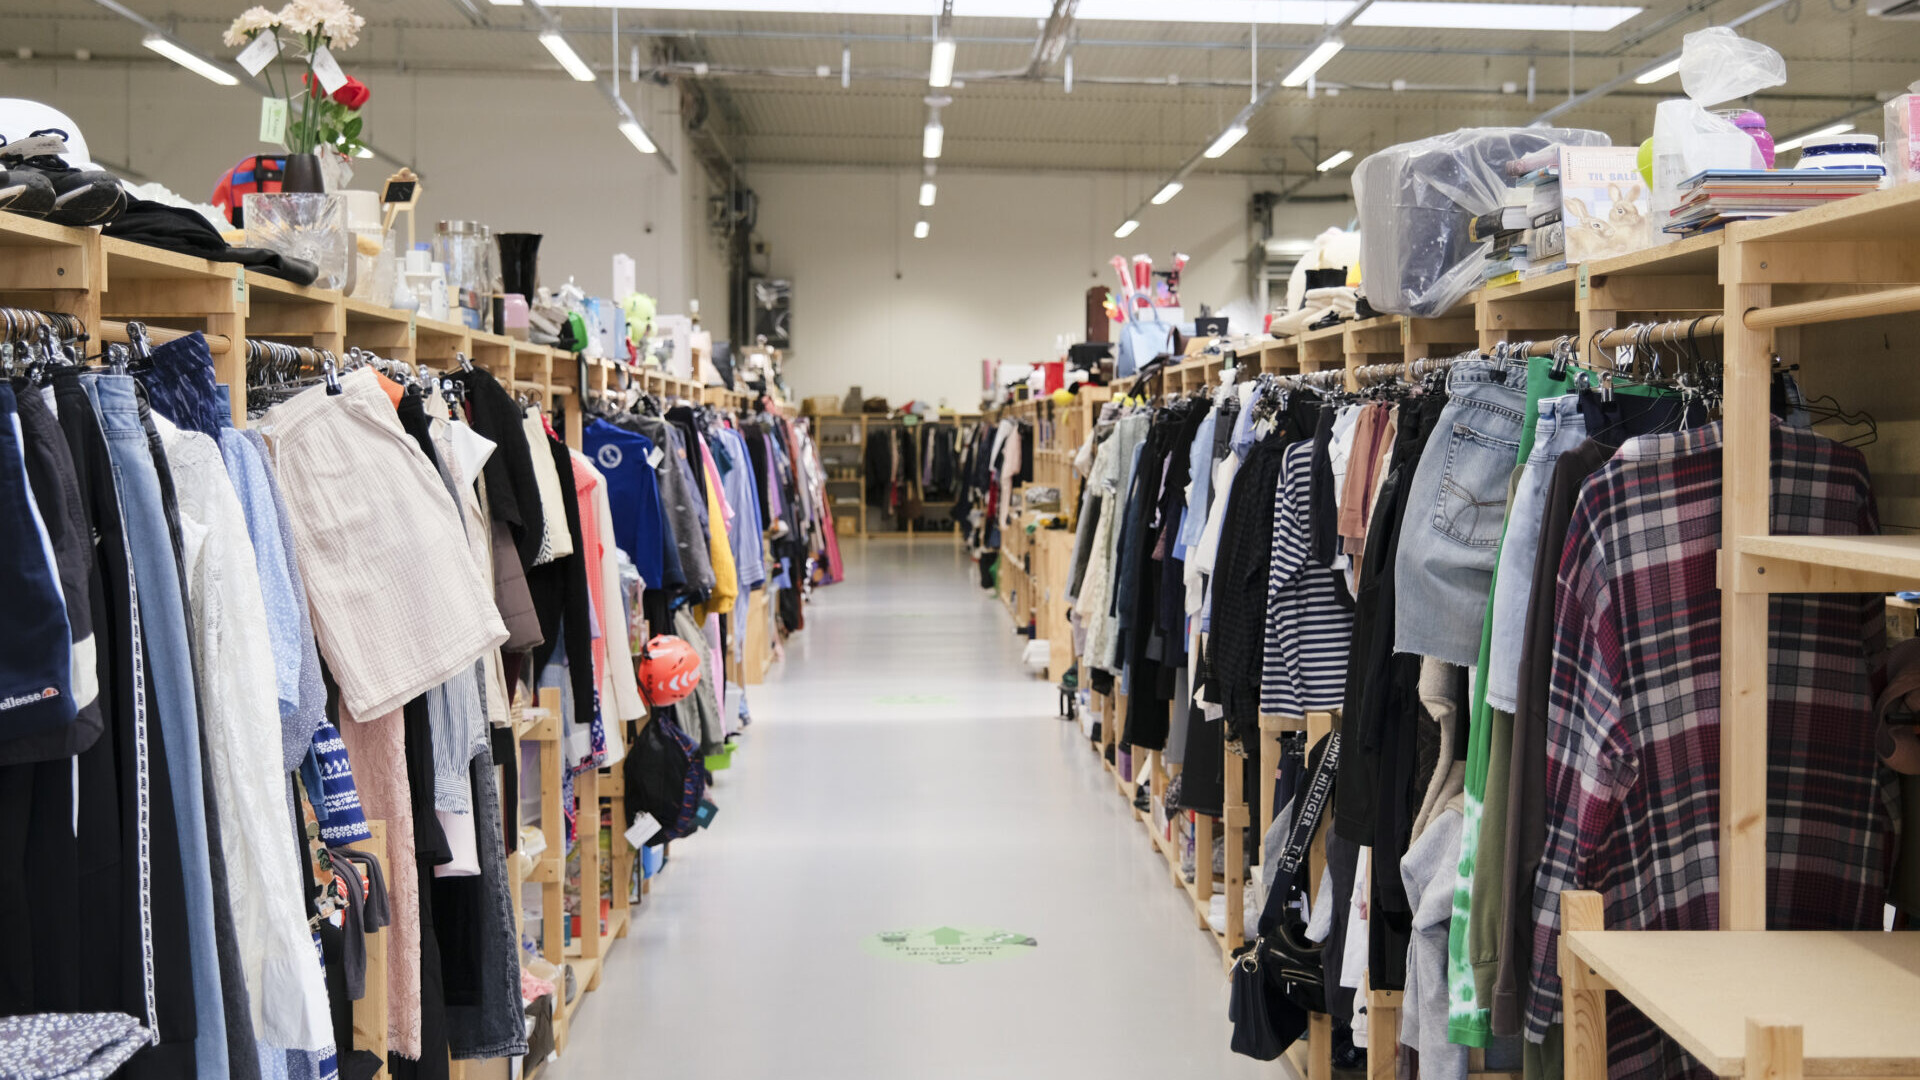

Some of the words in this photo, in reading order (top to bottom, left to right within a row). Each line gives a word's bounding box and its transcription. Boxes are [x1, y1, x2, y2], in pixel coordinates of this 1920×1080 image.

[1588, 172, 1605, 180] TIL
[0, 693, 41, 710] ellesse
[1301, 772, 1329, 827] HILFIGER
